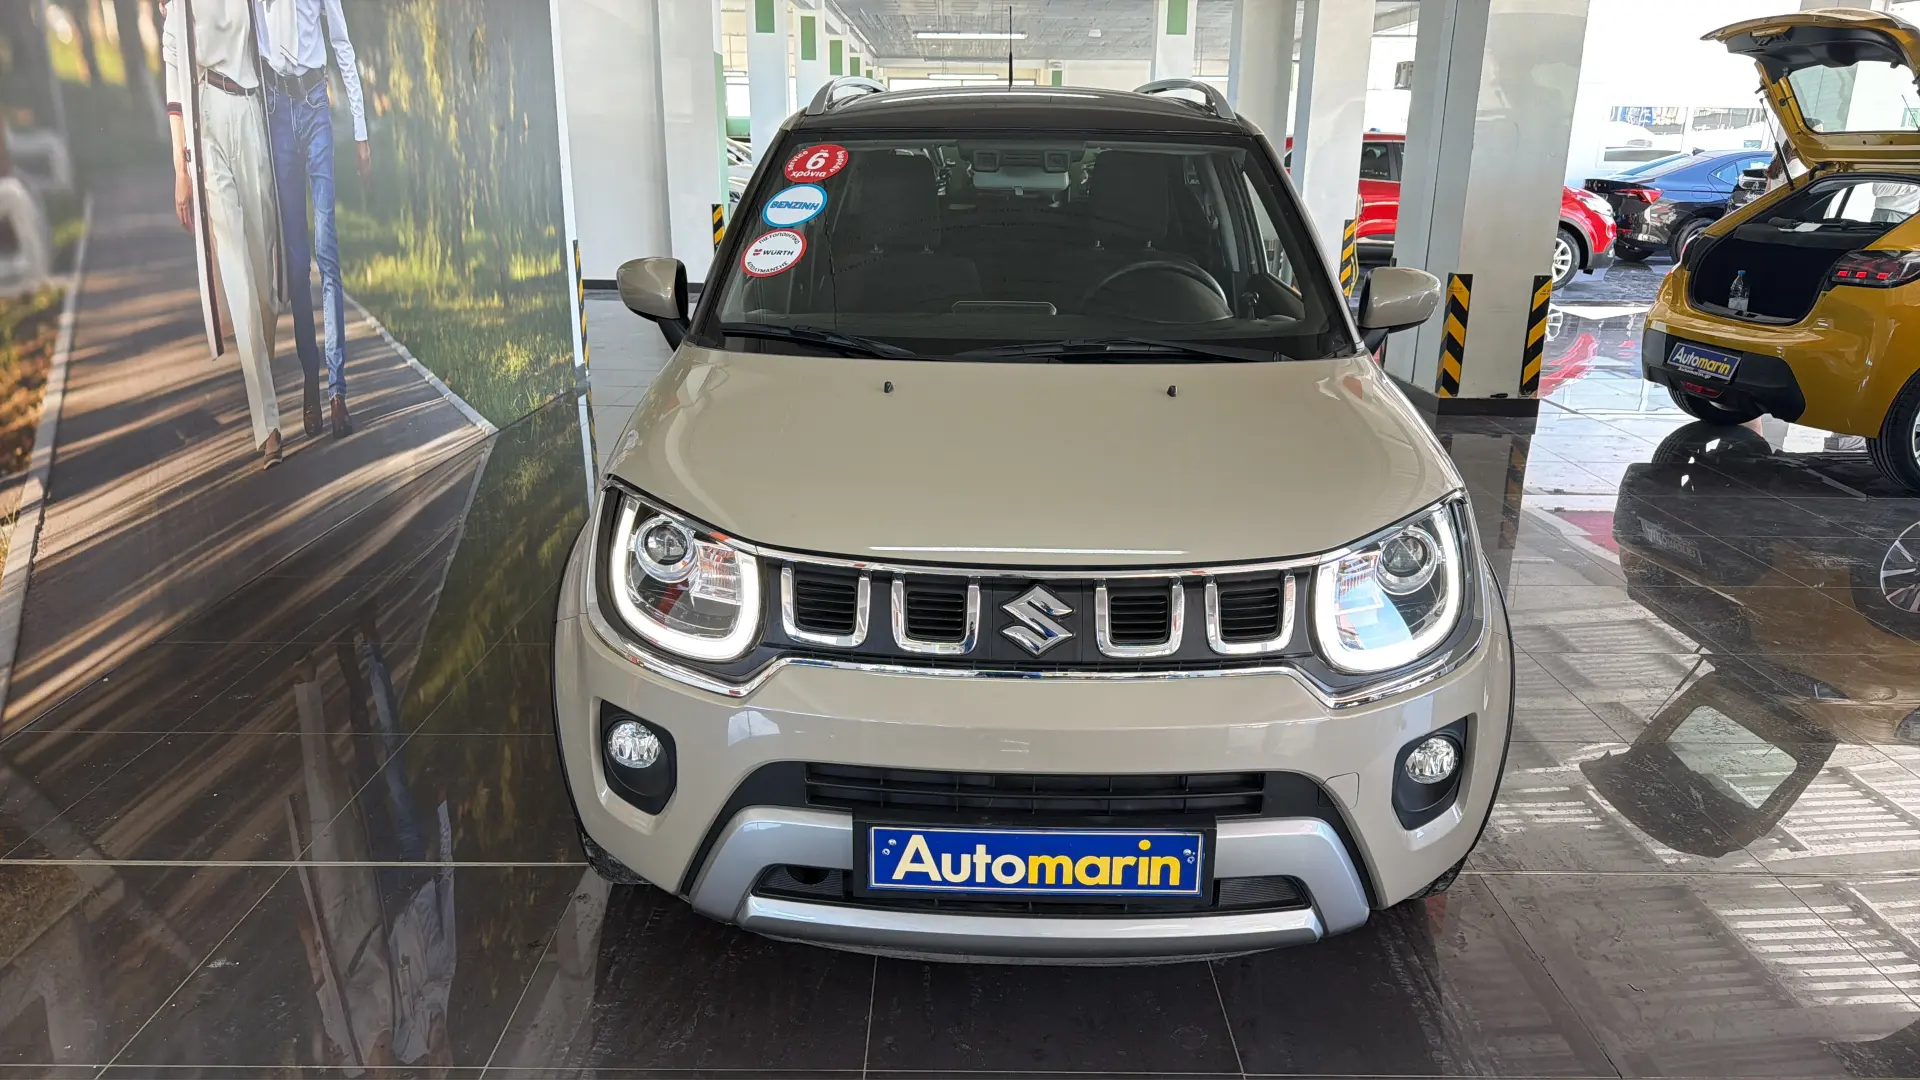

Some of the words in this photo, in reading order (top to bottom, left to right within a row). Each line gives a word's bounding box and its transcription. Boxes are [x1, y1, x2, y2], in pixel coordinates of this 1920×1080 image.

[806, 152, 829, 170] 6
[790, 170, 827, 178] χρόνια
[1672, 347, 1731, 375] Automarin
[891, 834, 1181, 886] Automarin
